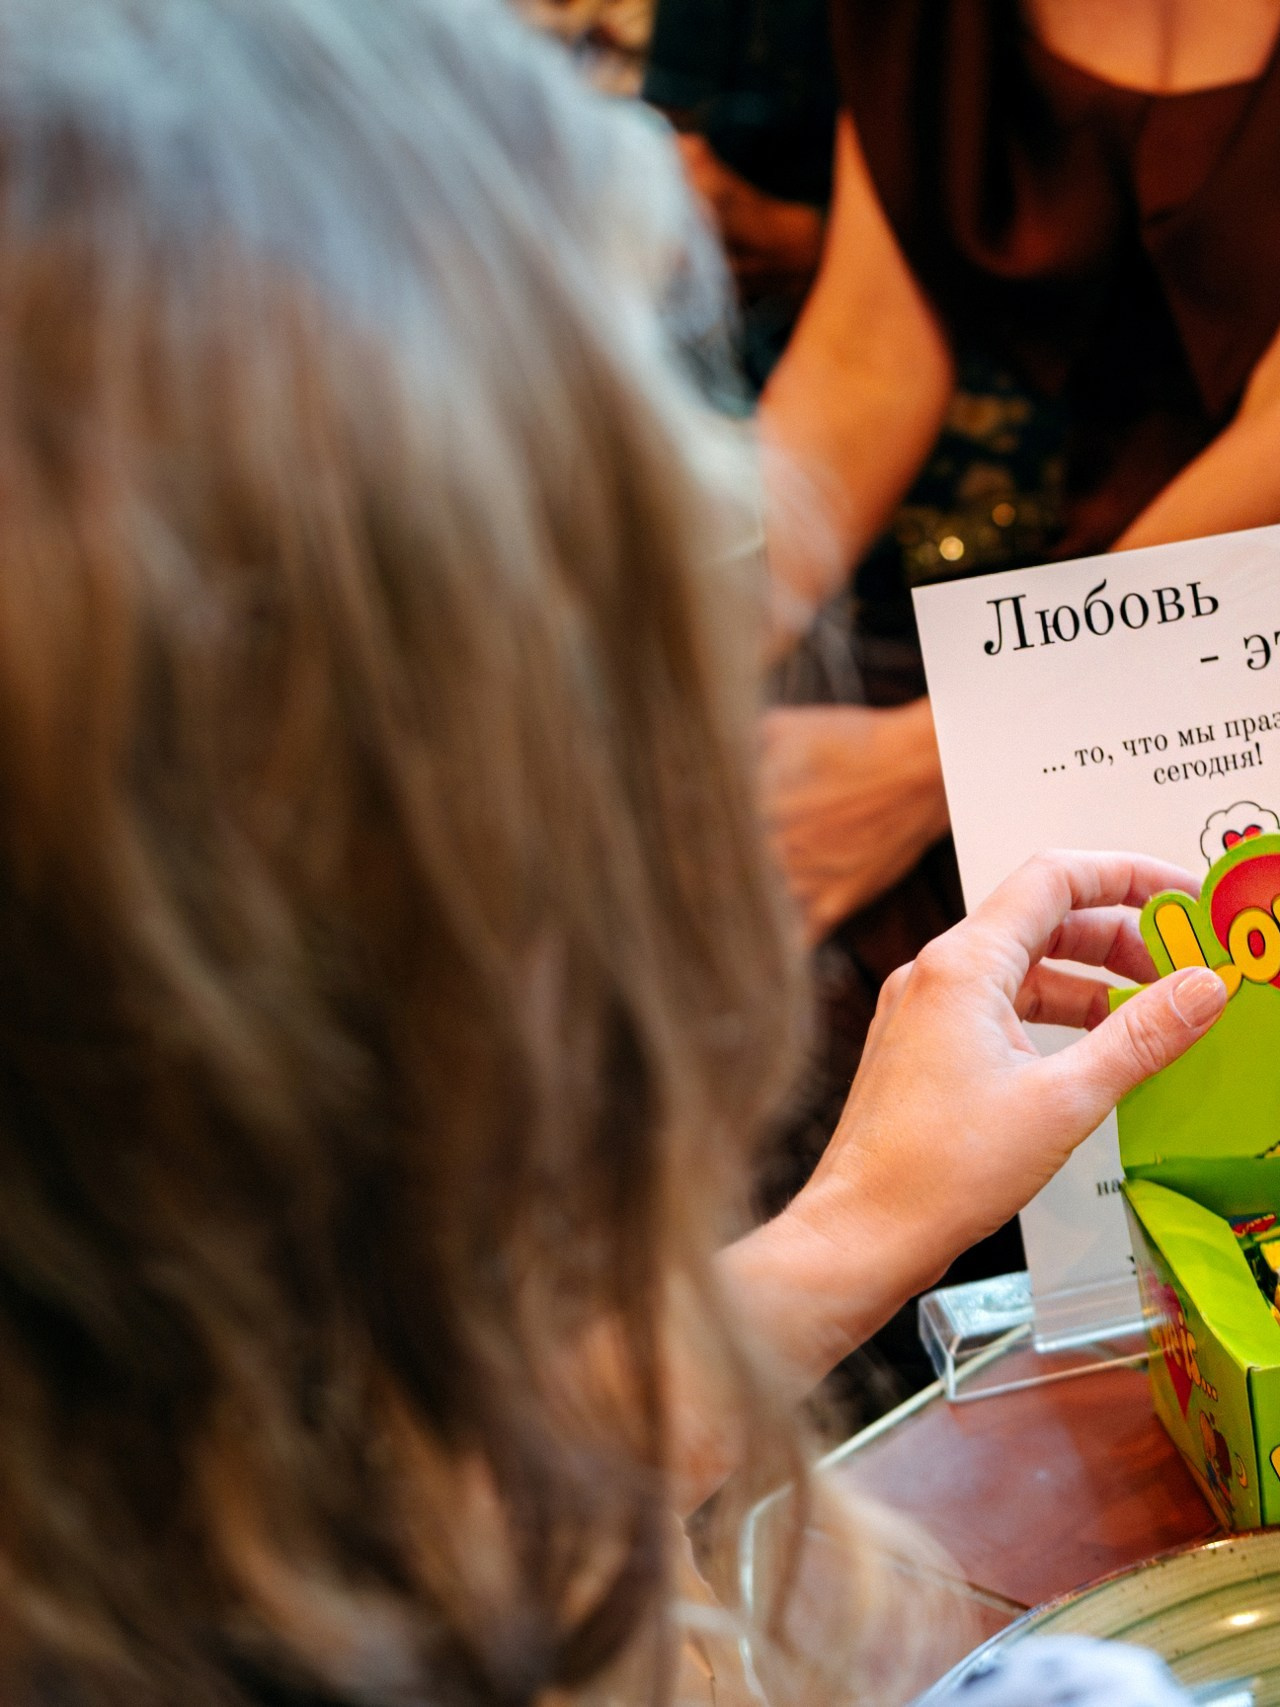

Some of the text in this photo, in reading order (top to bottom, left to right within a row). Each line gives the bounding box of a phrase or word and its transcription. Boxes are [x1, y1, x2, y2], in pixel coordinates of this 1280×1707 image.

[983, 578, 1220, 656] Любовь
[1074, 746, 1115, 767] то,
[1121, 734, 1168, 758] что
[1177, 724, 1216, 747] мы
[1153, 741, 1264, 785] сегодня!
